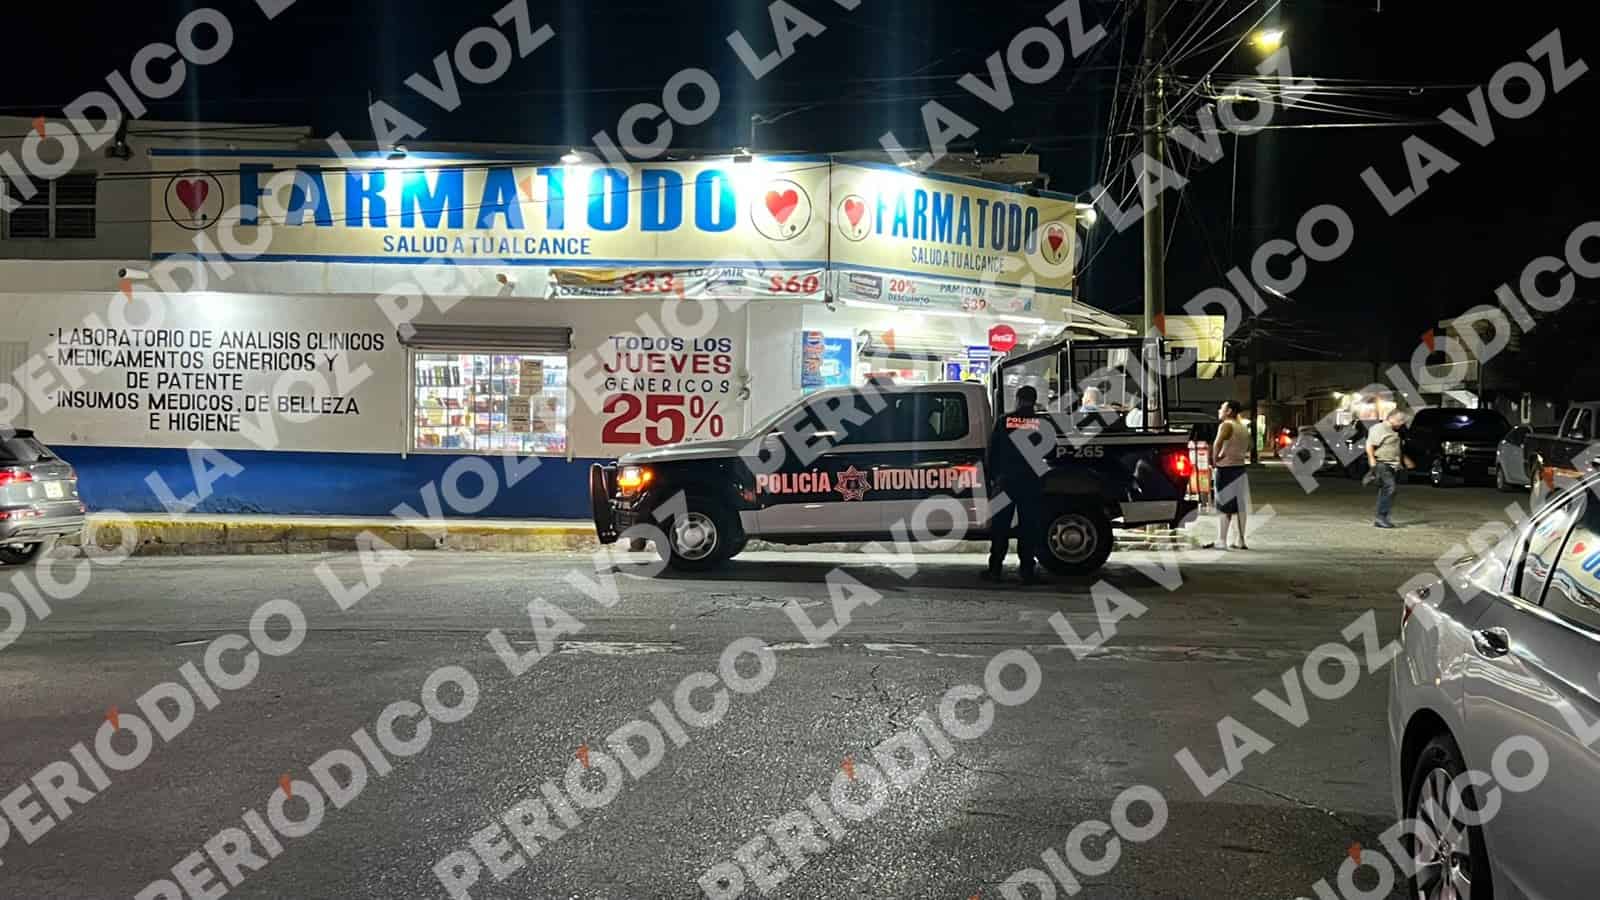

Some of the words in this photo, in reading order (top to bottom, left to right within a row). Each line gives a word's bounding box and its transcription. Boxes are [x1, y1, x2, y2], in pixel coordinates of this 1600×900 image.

[239, 163, 737, 233] FARMATODO
[874, 188, 1039, 256] FARMATODO
[383, 235, 447, 254] SALUD
[469, 236, 494, 255] TU
[497, 236, 591, 256] ALCANCE
[911, 246, 942, 266] SALUD
[963, 252, 1005, 275] ALCANCE
[888, 278, 917, 294] 20%
[189, 330, 213, 348] DE
[219, 330, 302, 350] ANALISIS
[306, 332, 385, 351] CLINICOS
[608, 335, 685, 351] TODOS
[694, 337, 732, 353] LOS
[212, 351, 316, 372] GENERICOS
[324, 353, 339, 372] Y
[603, 352, 732, 374] JUEVES
[126, 371, 150, 389] DE
[157, 372, 244, 391] PATENTE
[604, 377, 730, 394] GENERICOS
[246, 394, 270, 413] DE
[277, 396, 360, 415] BELLEZA
[149, 412, 161, 430] E
[168, 412, 241, 432] HIGIENE
[602, 392, 724, 447] 25%
[755, 468, 831, 494] POLICÍA
[873, 466, 982, 491] MUNICIPAL
